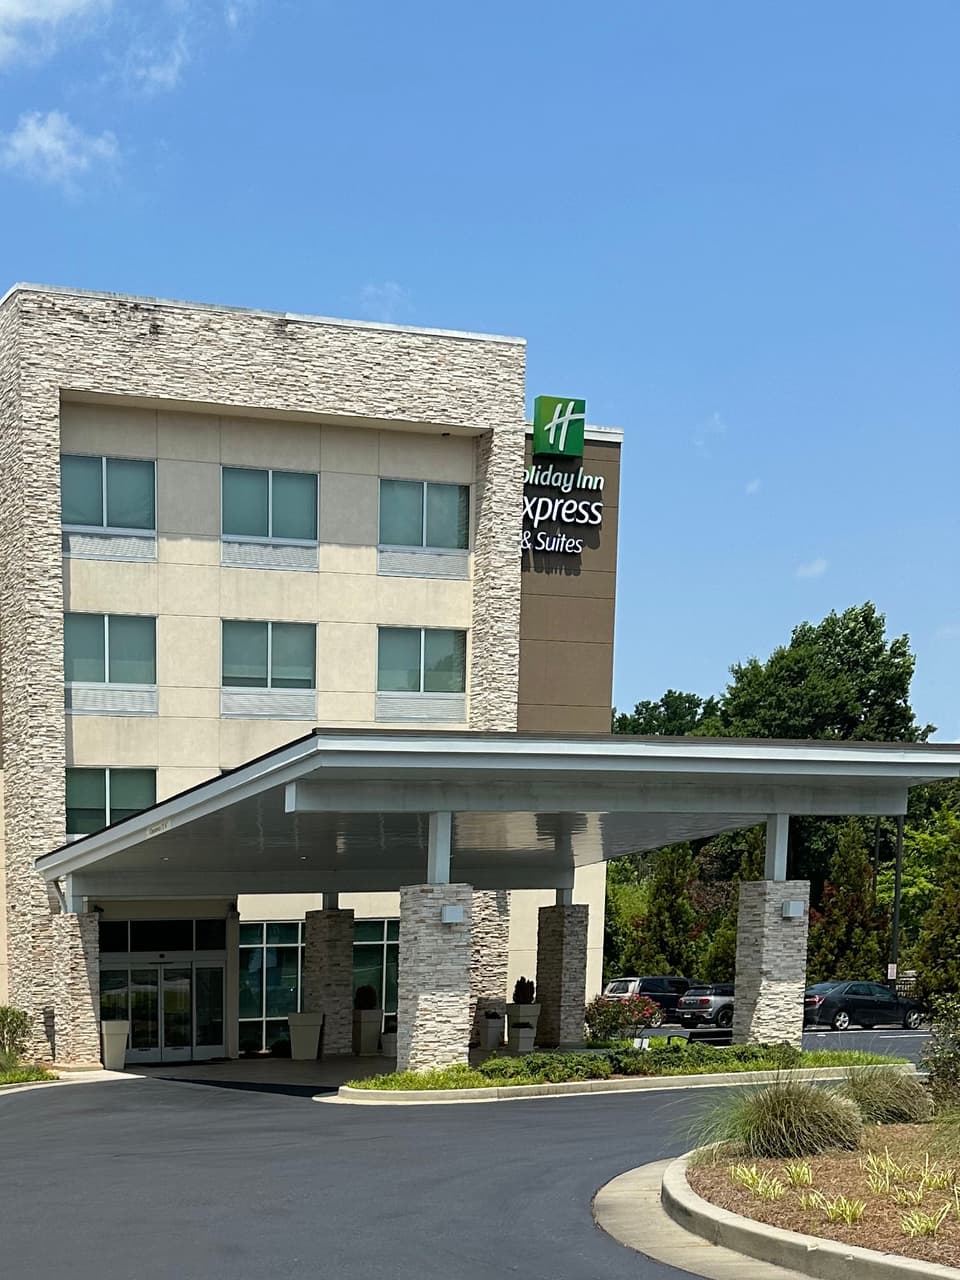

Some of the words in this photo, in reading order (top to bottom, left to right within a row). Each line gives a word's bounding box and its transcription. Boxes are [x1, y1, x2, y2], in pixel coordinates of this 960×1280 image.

[522, 464, 574, 493] oliday
[576, 466, 605, 491] Inn
[521, 495, 604, 529] xpress
[520, 530, 532, 549] &
[534, 531, 584, 554] Suites
